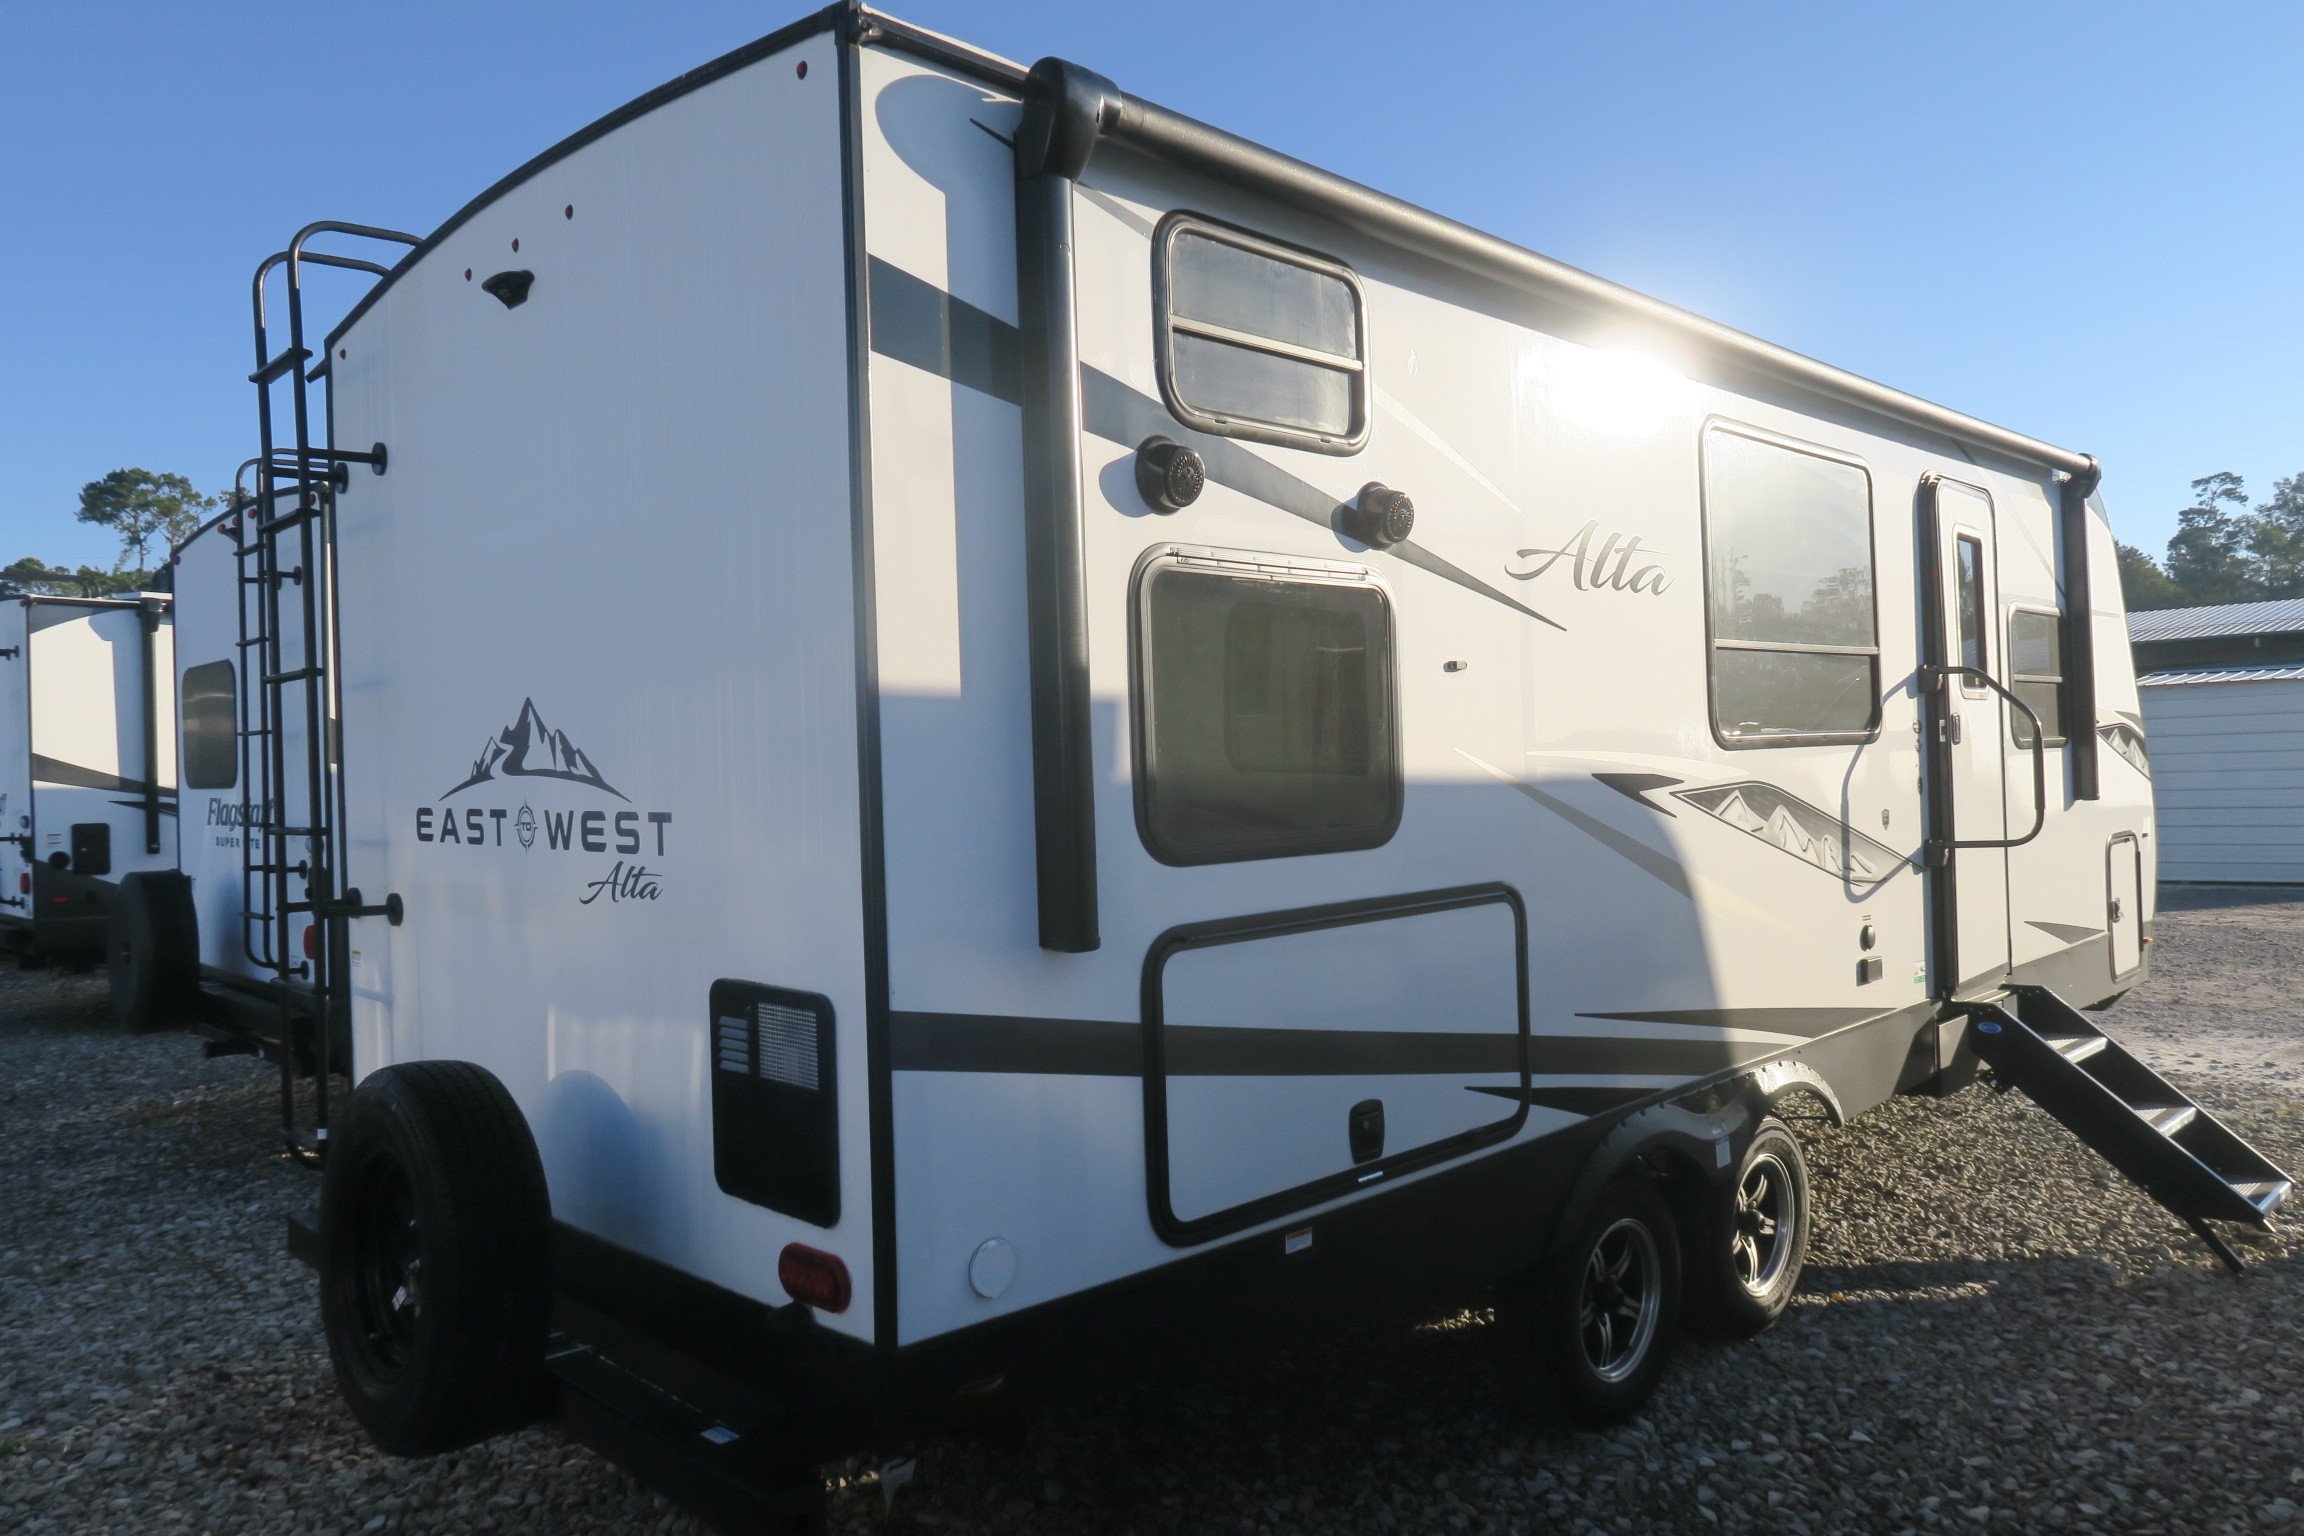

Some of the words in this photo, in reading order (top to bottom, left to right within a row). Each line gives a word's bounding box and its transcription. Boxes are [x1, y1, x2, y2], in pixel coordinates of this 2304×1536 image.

[1504, 519, 1676, 596] Alta
[207, 797, 277, 833] Flagsa
[416, 807, 508, 847] EAST
[521, 821, 532, 831] TO
[544, 809, 673, 857] WEST
[216, 836, 241, 849] SUPER
[578, 861, 664, 905] Alta
